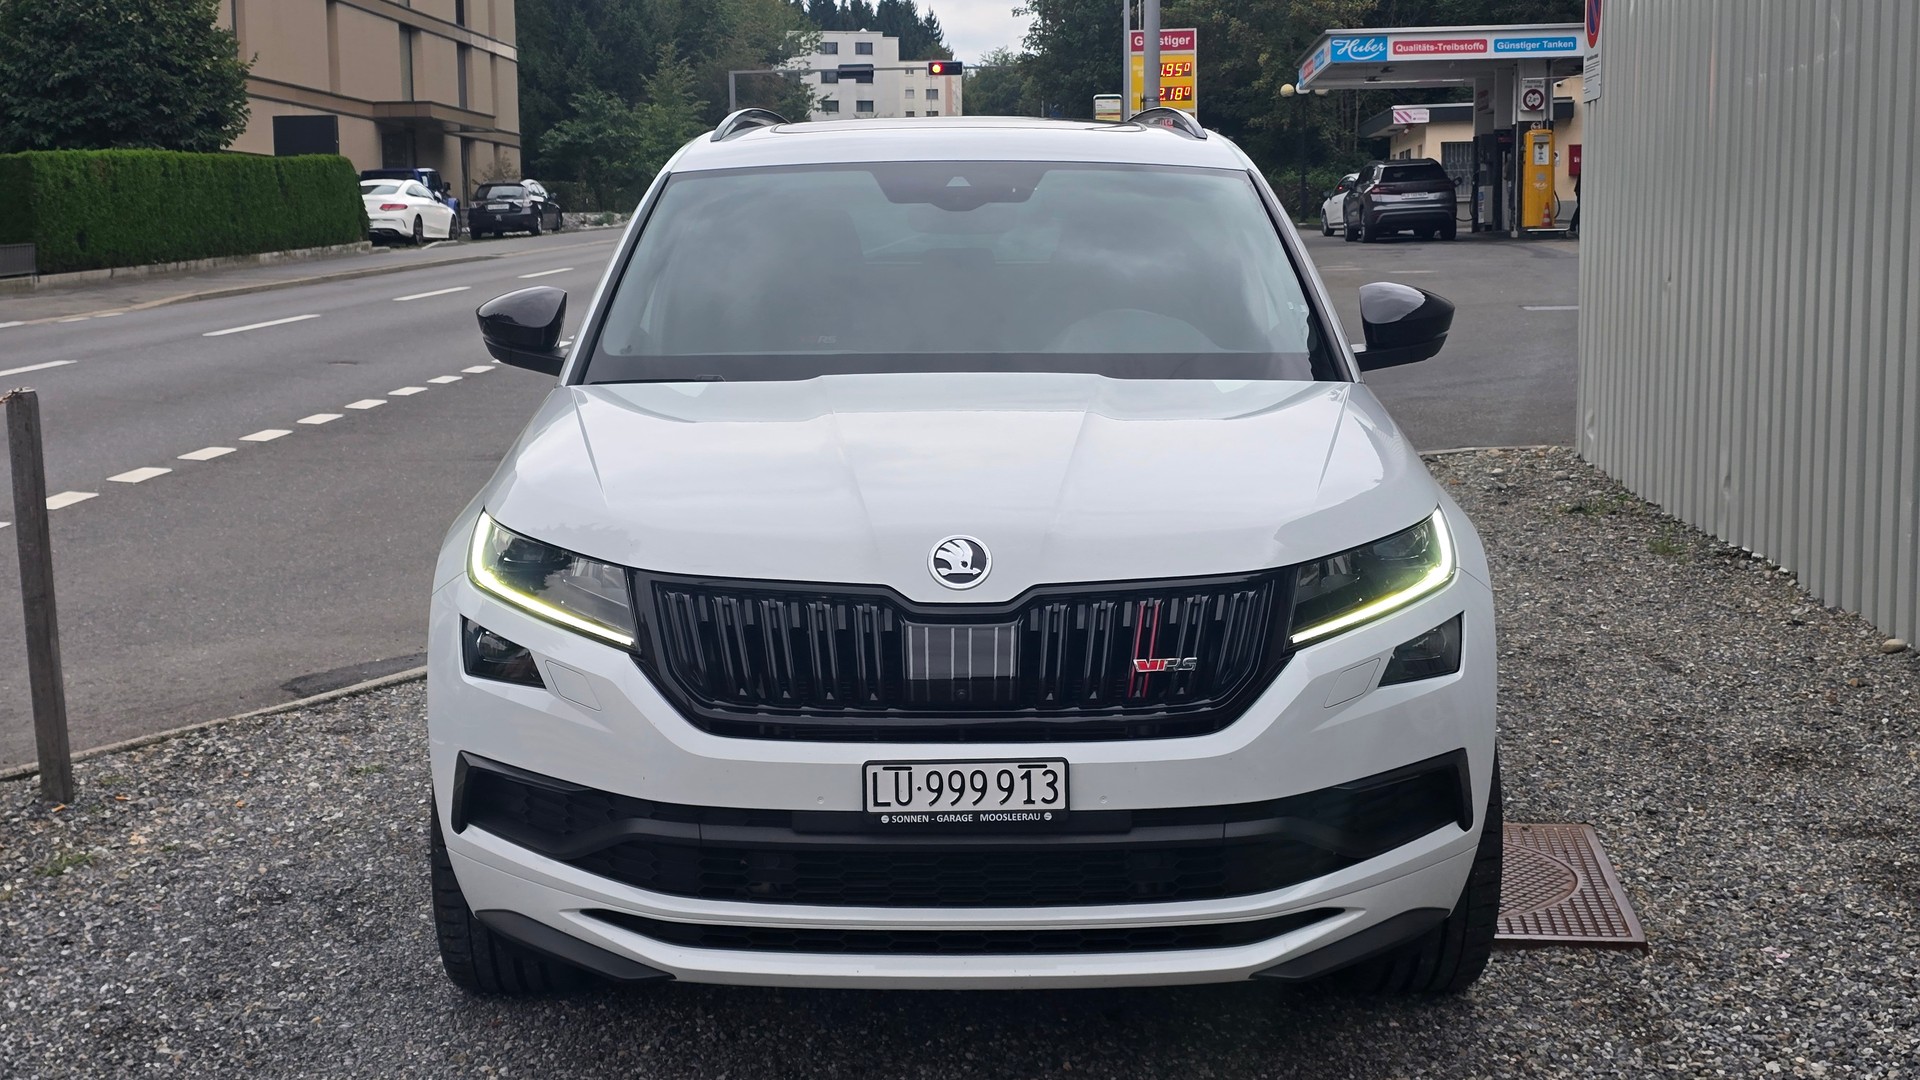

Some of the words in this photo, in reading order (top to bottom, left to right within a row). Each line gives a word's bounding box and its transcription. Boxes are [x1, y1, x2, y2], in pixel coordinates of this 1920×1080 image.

[1134, 35, 1191, 48] Gstiger
[1497, 41, 1540, 51] Günstiger
[1542, 40, 1574, 49] Tanken
[1332, 38, 1386, 61] Huber
[1395, 42, 1485, 53] Qualitäts-Treibstoffe
[891, 815, 929, 823] SONNEN
[936, 814, 973, 823] GARAGE
[979, 813, 1041, 822] MOOSLEERAU
